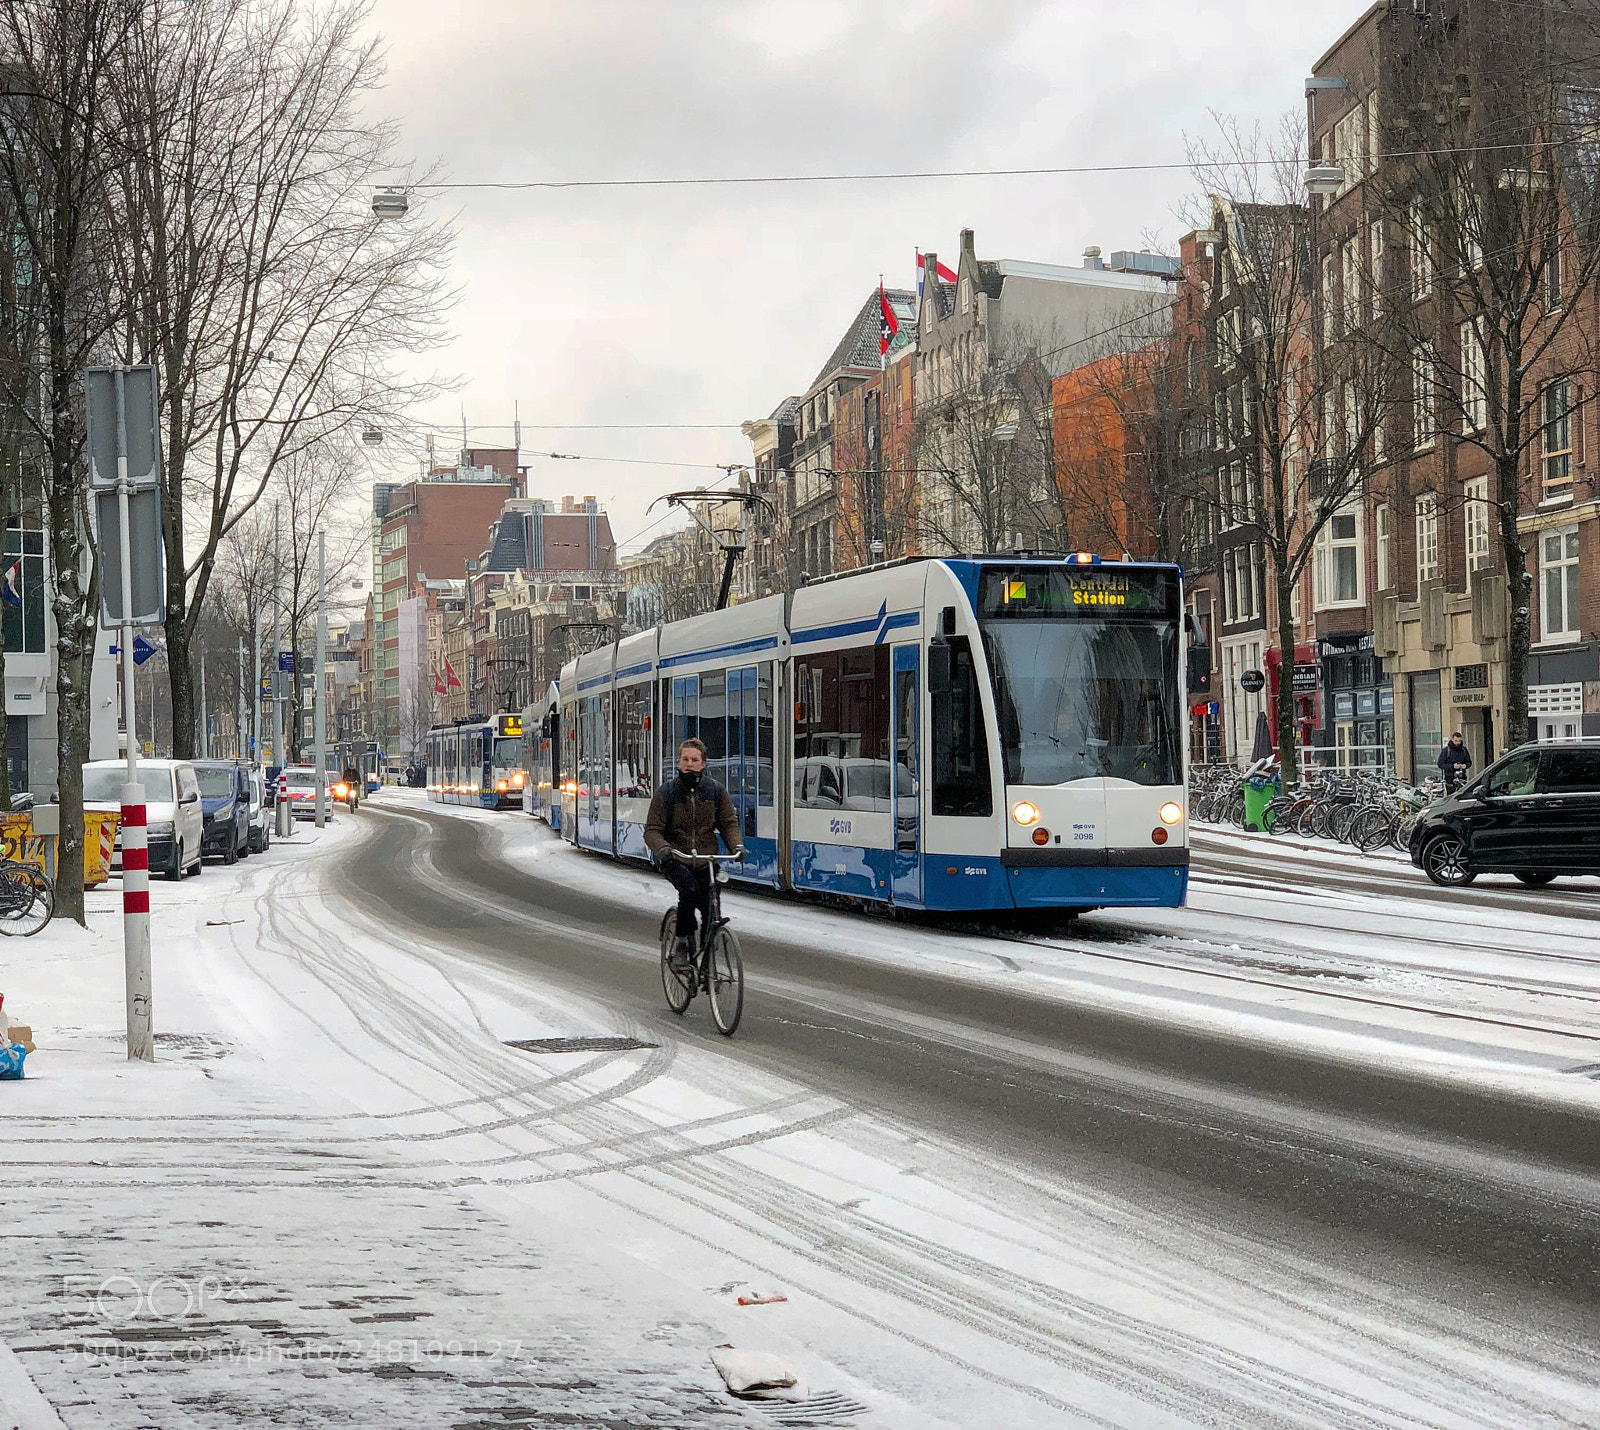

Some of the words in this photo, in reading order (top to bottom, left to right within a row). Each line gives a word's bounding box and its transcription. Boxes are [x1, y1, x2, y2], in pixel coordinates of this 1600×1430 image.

[1070, 576, 1129, 590] Centraal
[1001, 576, 1009, 604] 1
[1073, 591, 1125, 605] Station
[508, 717, 514, 727] 5
[840, 821, 852, 834] GVB
[1073, 832, 1094, 840] 2098
